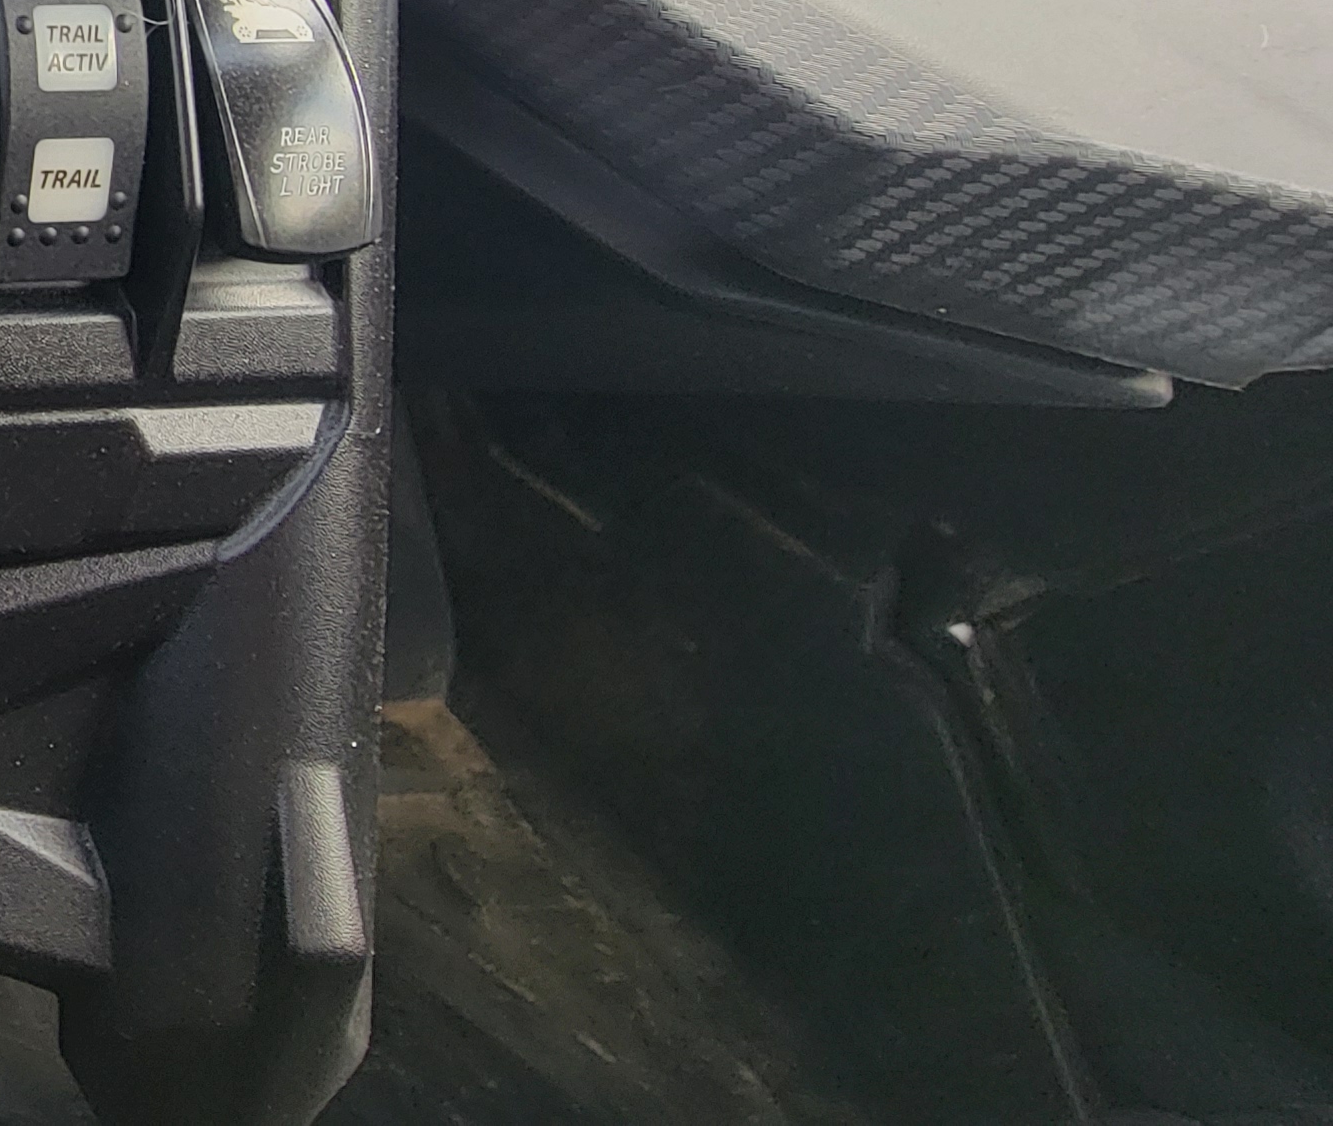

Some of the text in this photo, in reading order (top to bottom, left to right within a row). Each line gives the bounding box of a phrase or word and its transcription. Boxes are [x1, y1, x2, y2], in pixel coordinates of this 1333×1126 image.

[46, 24, 104, 43] TRAIL
[47, 53, 109, 72] ACTIV
[280, 127, 331, 147] REAR
[270, 151, 347, 173] STROBE
[39, 170, 102, 189] TRAIL
[279, 176, 344, 197] LIGHT
